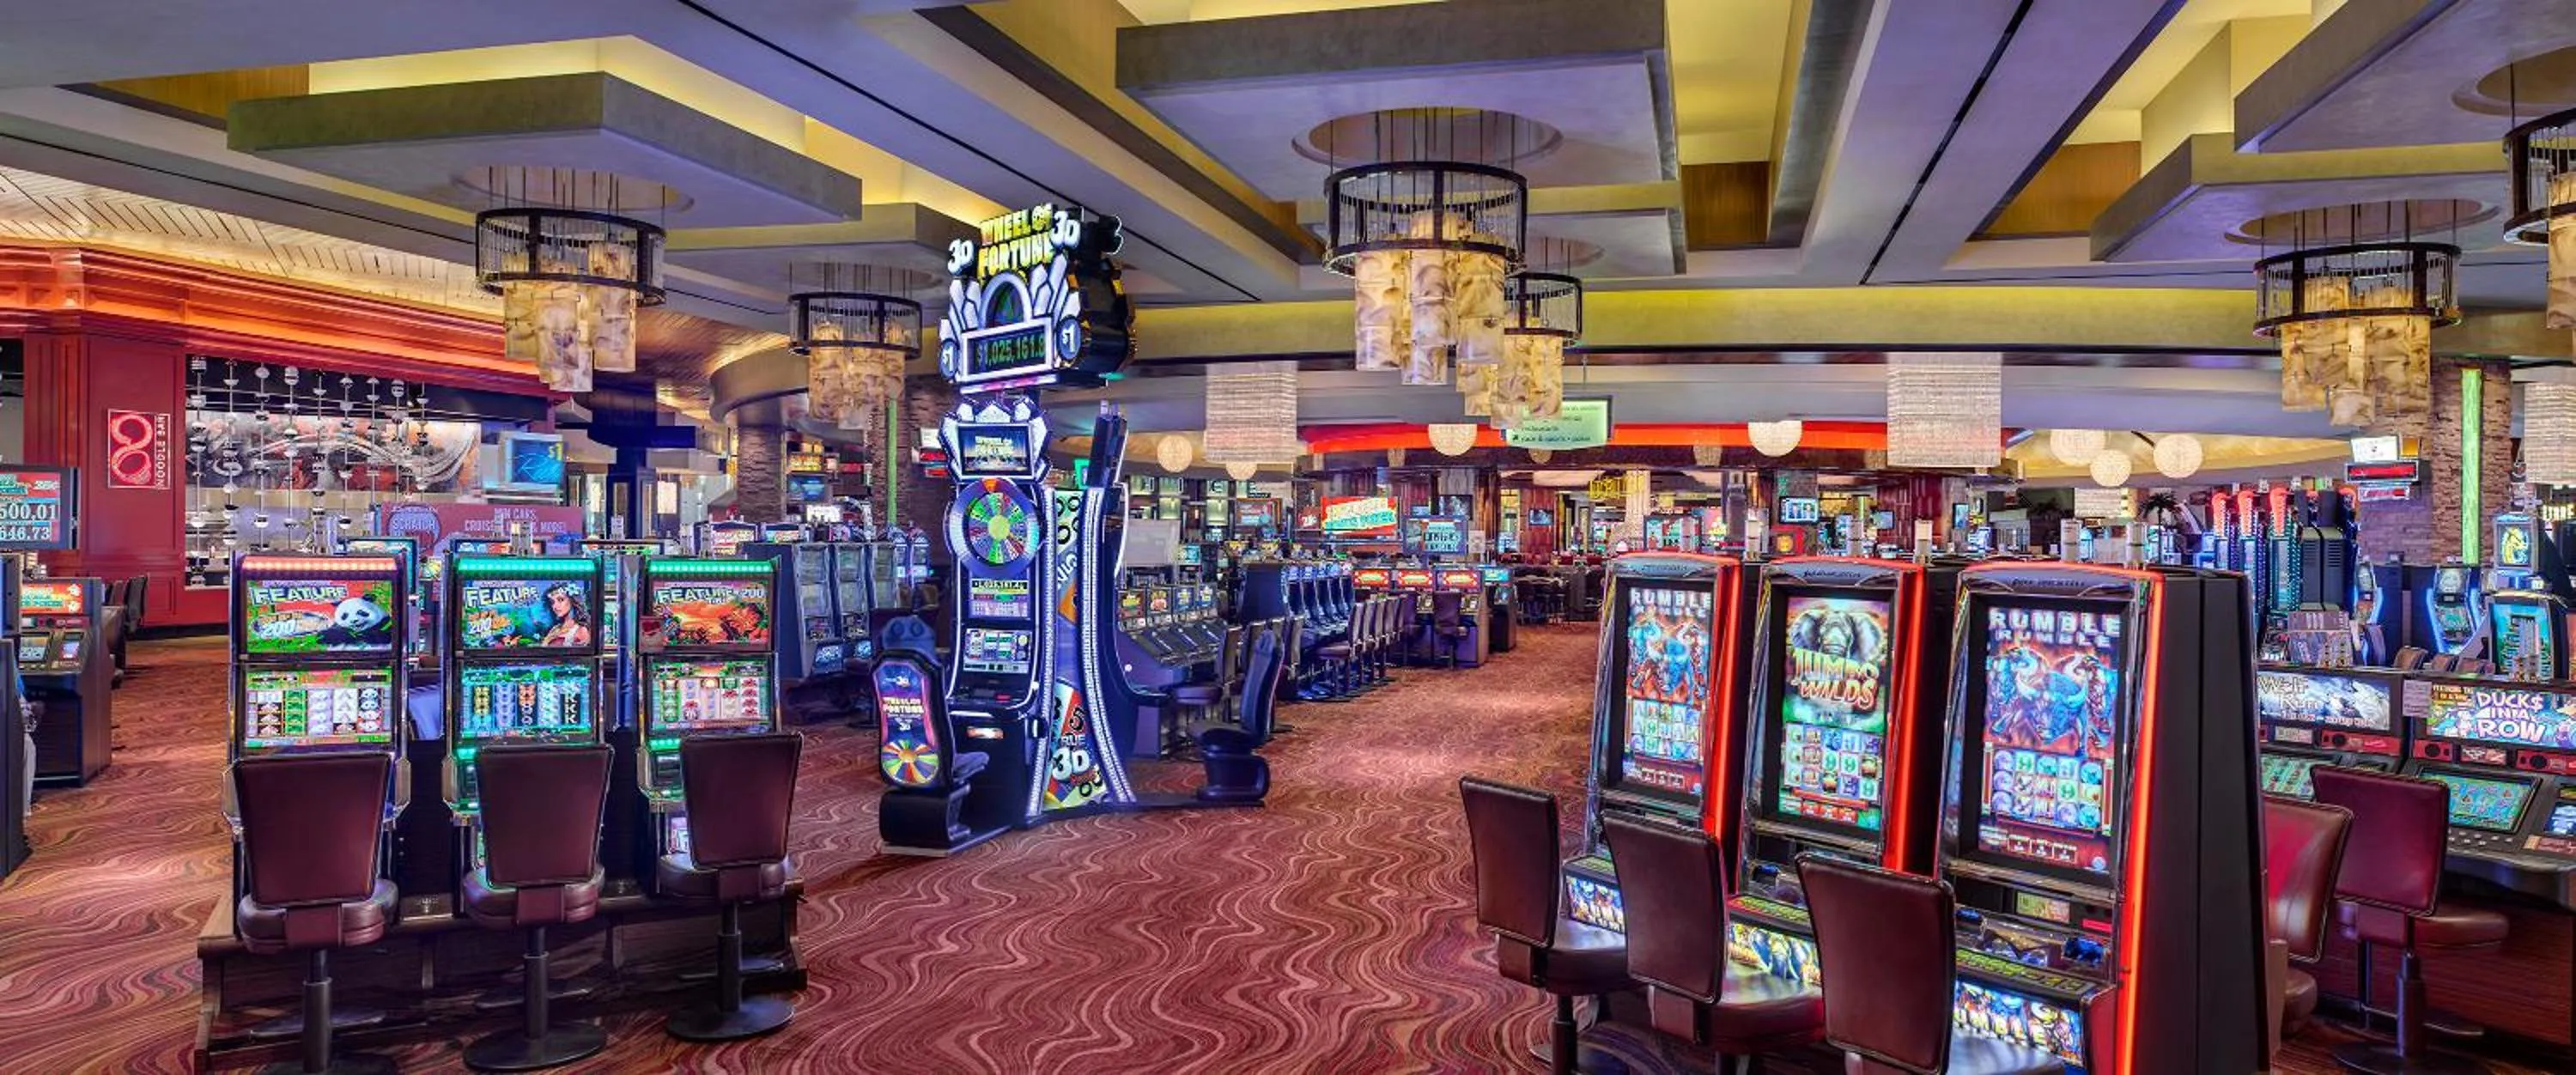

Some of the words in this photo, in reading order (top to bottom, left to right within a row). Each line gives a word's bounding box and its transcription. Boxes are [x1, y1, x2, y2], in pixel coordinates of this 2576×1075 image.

[980, 209, 1031, 246] WHEEL
[1048, 210, 1080, 250] 3D
[948, 239, 974, 274] 3D
[977, 232, 1054, 279] FORTUNE
[156, 440, 166, 488] NOODLE
[252, 586, 347, 604] FEATURE
[465, 586, 538, 607] FEATURE
[656, 587, 733, 604] FEATURE
[1631, 587, 1711, 610] RUMBLE
[1988, 607, 2121, 637] RUMBLE
[1791, 648, 1880, 686] JUMBO
[1799, 677, 1876, 710] WILDS
[2258, 676, 2308, 695] Wolf
[2280, 694, 2318, 710] Run
[2477, 718, 2545, 743] ROW
[1052, 748, 1091, 781] 3D
[1953, 1005, 2048, 1046] UMBLE
